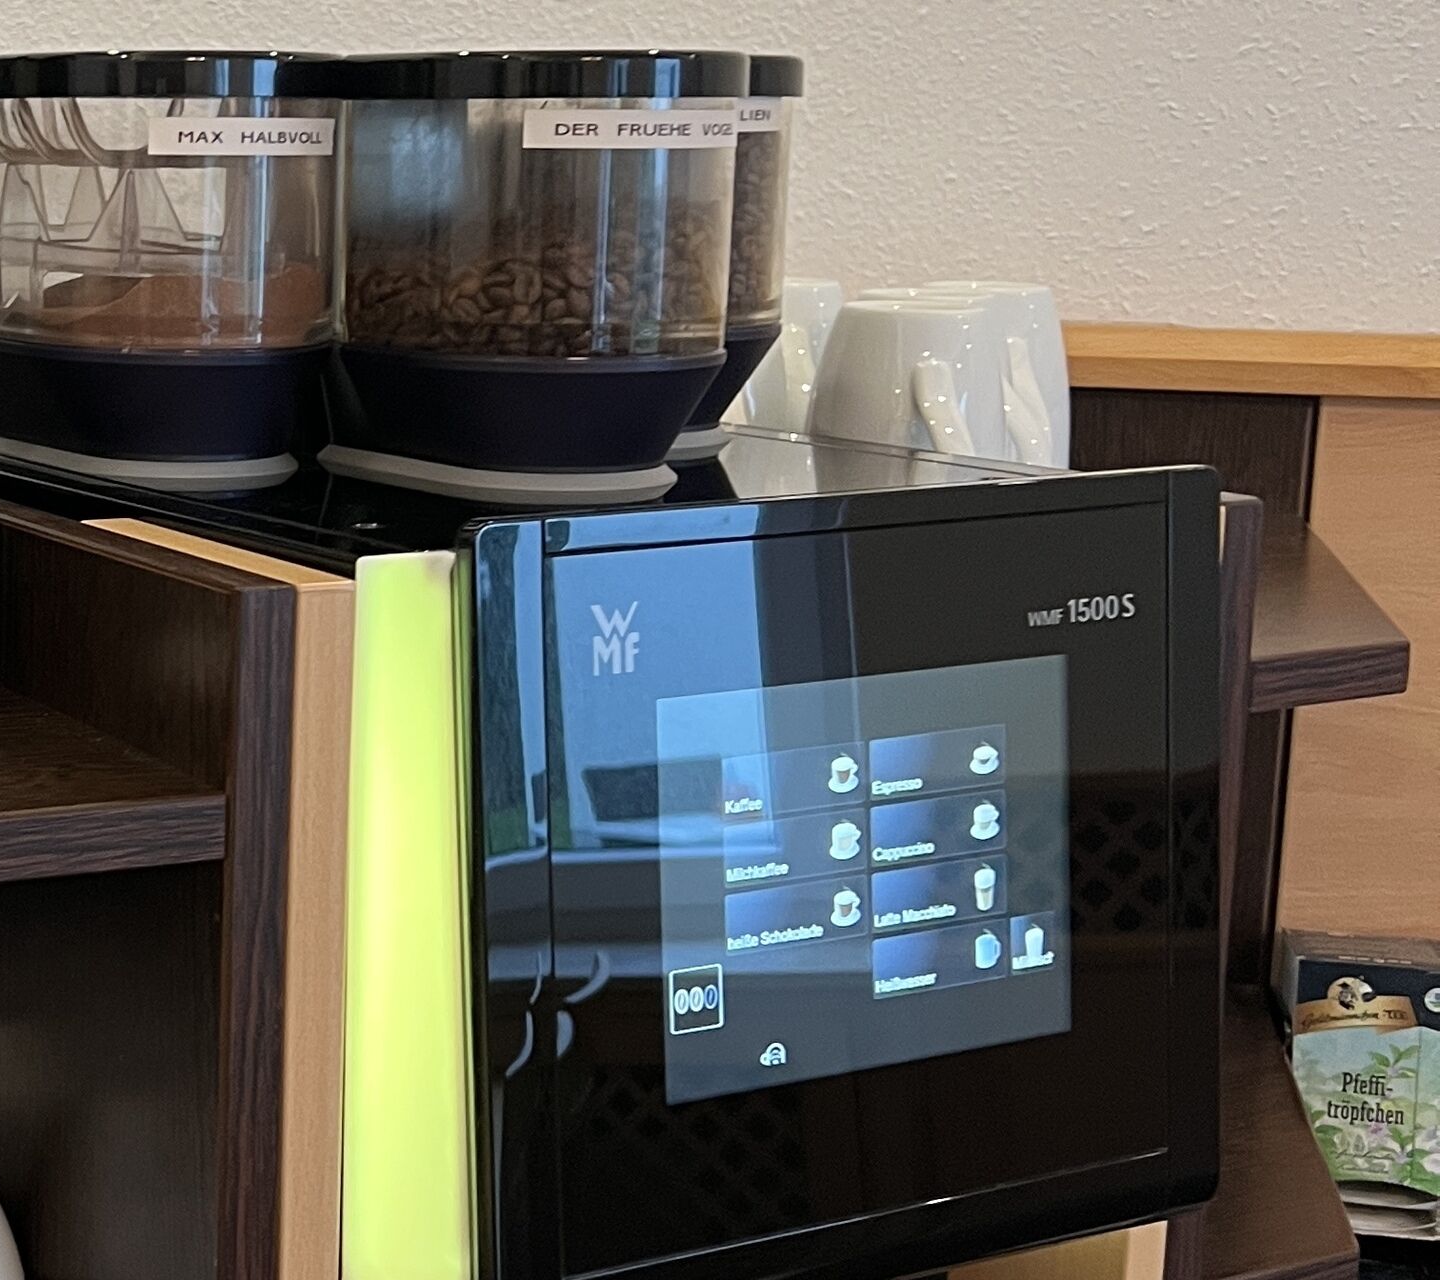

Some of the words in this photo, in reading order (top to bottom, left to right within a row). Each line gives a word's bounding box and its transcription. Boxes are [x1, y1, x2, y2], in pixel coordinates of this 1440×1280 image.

[177, 130, 224, 145] MAX
[240, 130, 323, 145] HALBVOLL
[554, 122, 599, 137] DER
[616, 122, 692, 137] FRUEHE
[590, 600, 640, 677] WMF
[724, 797, 763, 814] Kaffee
[1327, 1099, 1405, 1126] tröpfchen
